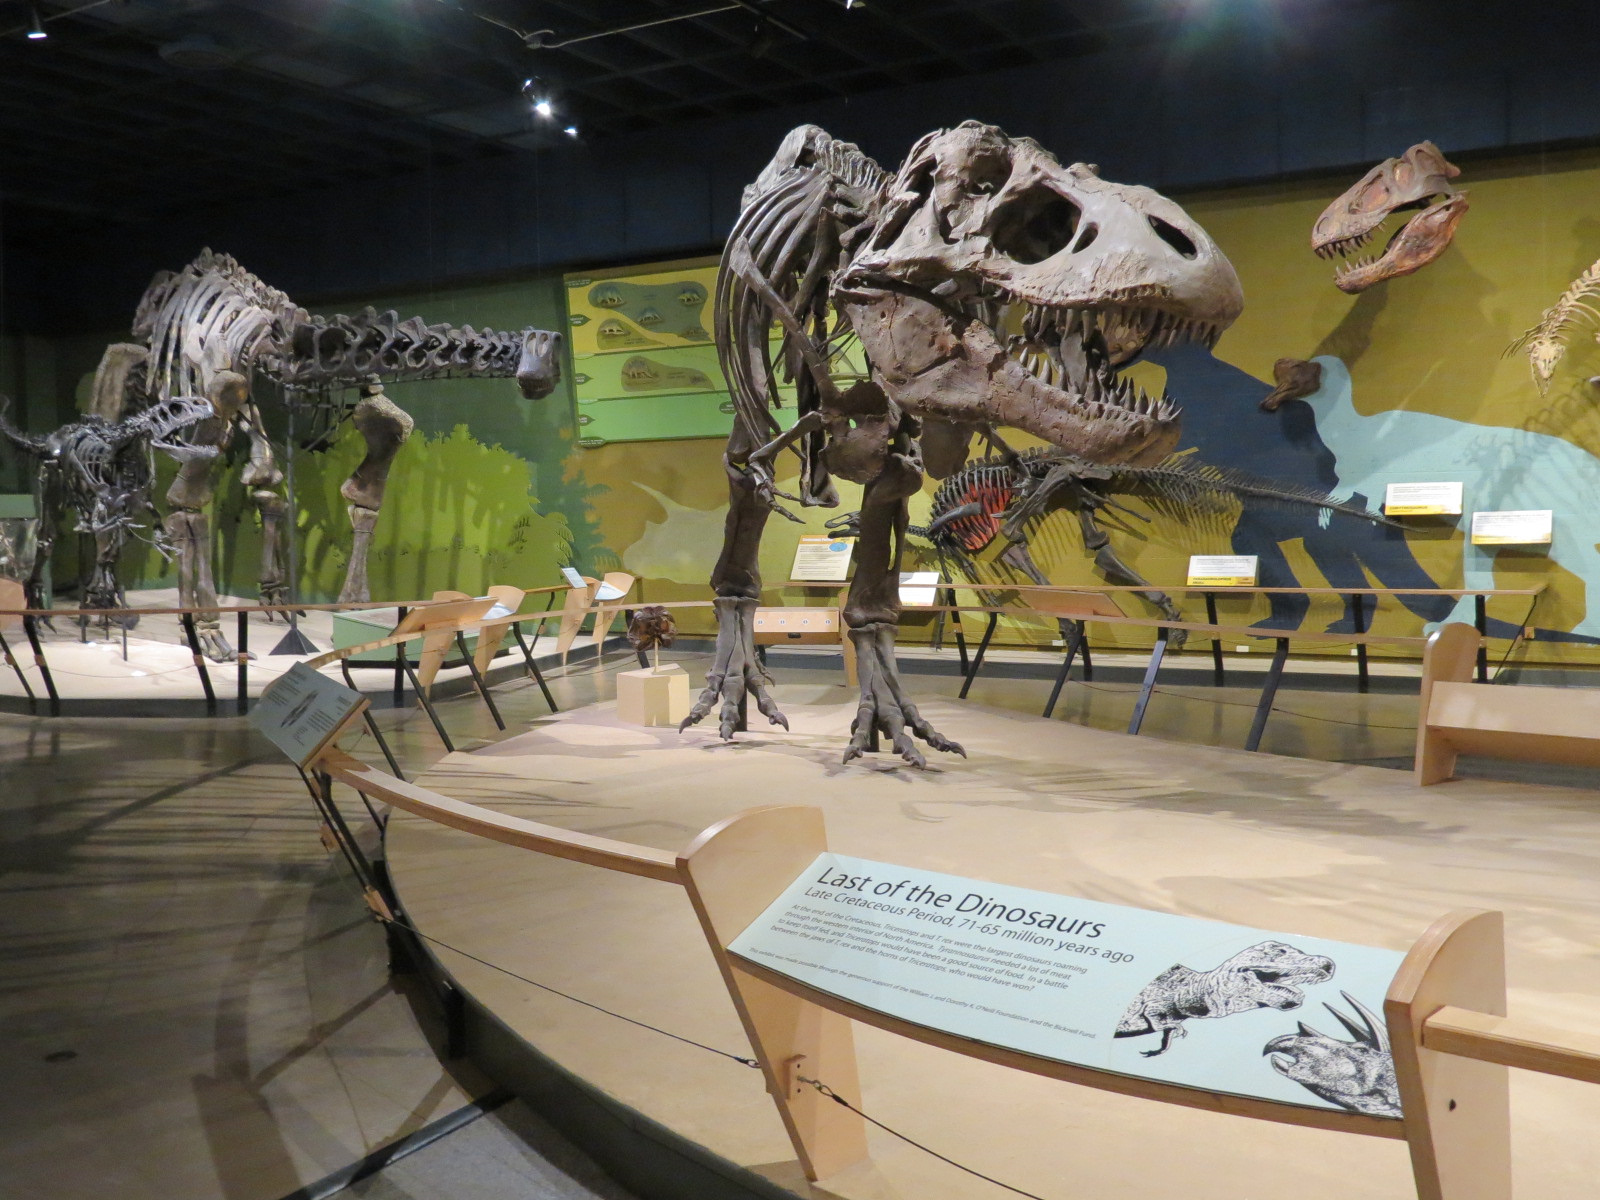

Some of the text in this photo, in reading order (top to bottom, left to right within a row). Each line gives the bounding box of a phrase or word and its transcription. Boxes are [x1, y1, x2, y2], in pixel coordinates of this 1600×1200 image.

[804, 886, 1134, 964] Late Cretaceous Period, 71-65 million years ago
[817, 866, 1106, 938] Last of the Dinosaurs
[770, 925, 798, 935] between
[878, 951, 898, 960] horns
[909, 957, 946, 972] Triceratops,
[949, 968, 966, 976] who
[967, 972, 992, 982] would
[991, 976, 1011, 987] have
[1012, 982, 1035, 992] won?
[784, 911, 810, 921] through
[822, 921, 849, 929] western
[849, 926, 875, 935] interior
[882, 932, 904, 942] North
[904, 938, 934, 949] America.
[938, 946, 991, 962] Tyrannosaurus
[990, 958, 1021, 969] needed
[1050, 970, 1072, 980] meat
[846, 933, 880, 946] Triceratops
[881, 943, 904, 951] would
[903, 947, 921, 956] have
[922, 951, 940, 960] been
[946, 958, 969, 967] good
[969, 964, 994, 972] source
[1004, 970, 1024, 980] food.
[1043, 979, 1069, 989] battle
[884, 924, 918, 936] Triceratops
[986, 946, 1013, 957] largest
[1014, 952, 1052, 966] dinosaurs
[1053, 962, 1088, 974] roaming
[818, 965, 838, 973] through
[872, 979, 893, 988] support
[946, 997, 969, 1007] Dorothy
[995, 1009, 1029, 1022] Foundation
[1079, 1030, 1096, 1039] Fund.
